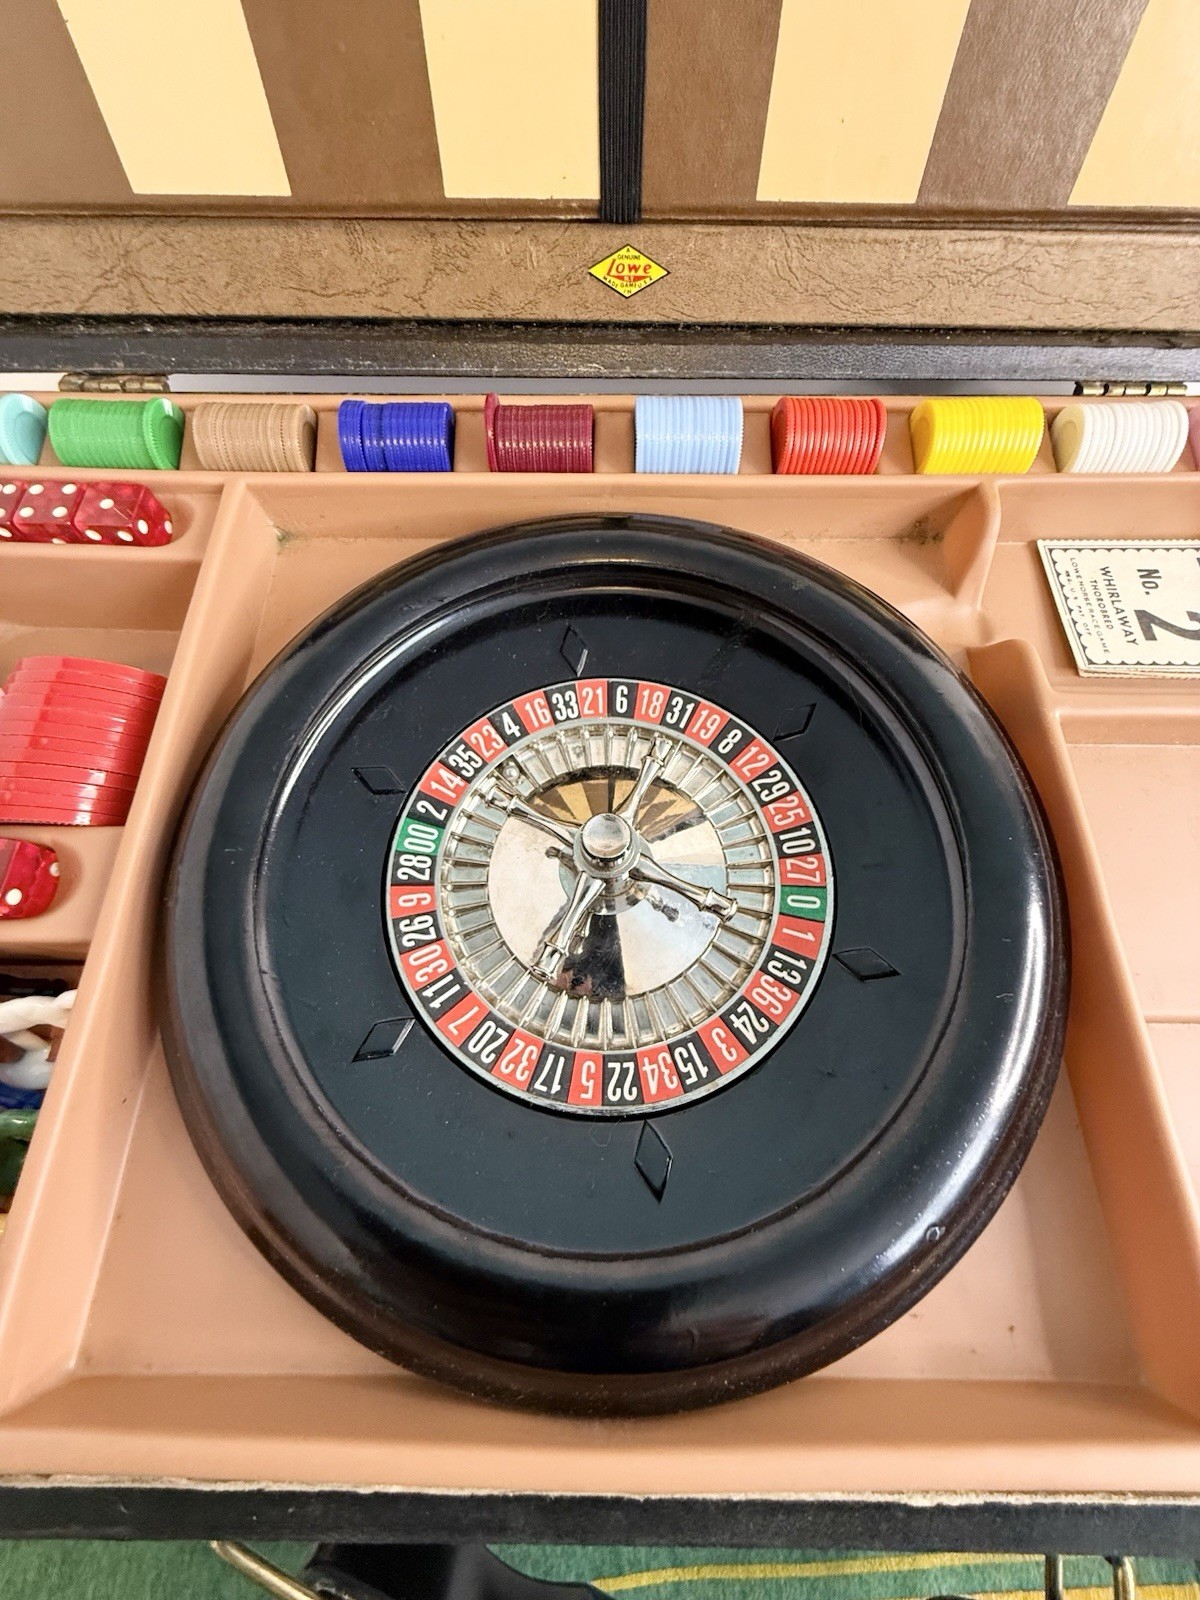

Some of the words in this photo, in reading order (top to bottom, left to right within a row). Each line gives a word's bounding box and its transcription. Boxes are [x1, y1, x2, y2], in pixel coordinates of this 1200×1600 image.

[603, 276, 618, 287] MADE
[606, 259, 651, 276] Lowe
[1137, 569, 1162, 595] No.
[1070, 558, 1082, 579] LOWE
[1079, 581, 1092, 606] HORSE
[1089, 608, 1100, 628] RACE
[1097, 631, 1110, 653] GAME
[1090, 580, 1114, 629] THOROBRED
[1099, 566, 1139, 645] WHIRLAWAY
[525, 697, 551, 727] 16
[552, 690, 579, 721] 33
[582, 686, 604, 715] 21
[615, 685, 629, 714] 6
[641, 688, 664, 719] 18
[666, 697, 694, 729] 31
[502, 712, 521, 737] 4
[692, 708, 720, 740] 19
[471, 724, 504, 758] 23
[718, 729, 742, 754] 8
[449, 744, 483, 778] 35
[736, 745, 770, 777] 12
[431, 769, 465, 799] 14
[752, 769, 790, 802] 29
[416, 800, 447, 821] 2
[768, 796, 805, 827] 25
[404, 824, 438, 853] 00
[779, 827, 815, 854] 10
[397, 855, 431, 881] 28
[786, 857, 821, 883] 27
[398, 892, 432, 907] 9
[787, 894, 821, 909] 0
[399, 915, 436, 947] 26
[782, 927, 816, 943] 1
[409, 943, 448, 983] 30
[767, 950, 807, 985] 13
[422, 973, 461, 1009] 11
[752, 976, 792, 1015] 36
[447, 1006, 479, 1035] 7
[730, 1001, 770, 1045] 24
[468, 1021, 510, 1064] 20
[712, 1028, 737, 1062] 3
[500, 1039, 538, 1082] 32
[534, 1053, 565, 1094] 17
[642, 1053, 678, 1095] 34
[674, 1043, 709, 1086] 15
[581, 1061, 596, 1099] 5
[607, 1062, 638, 1102] 22
